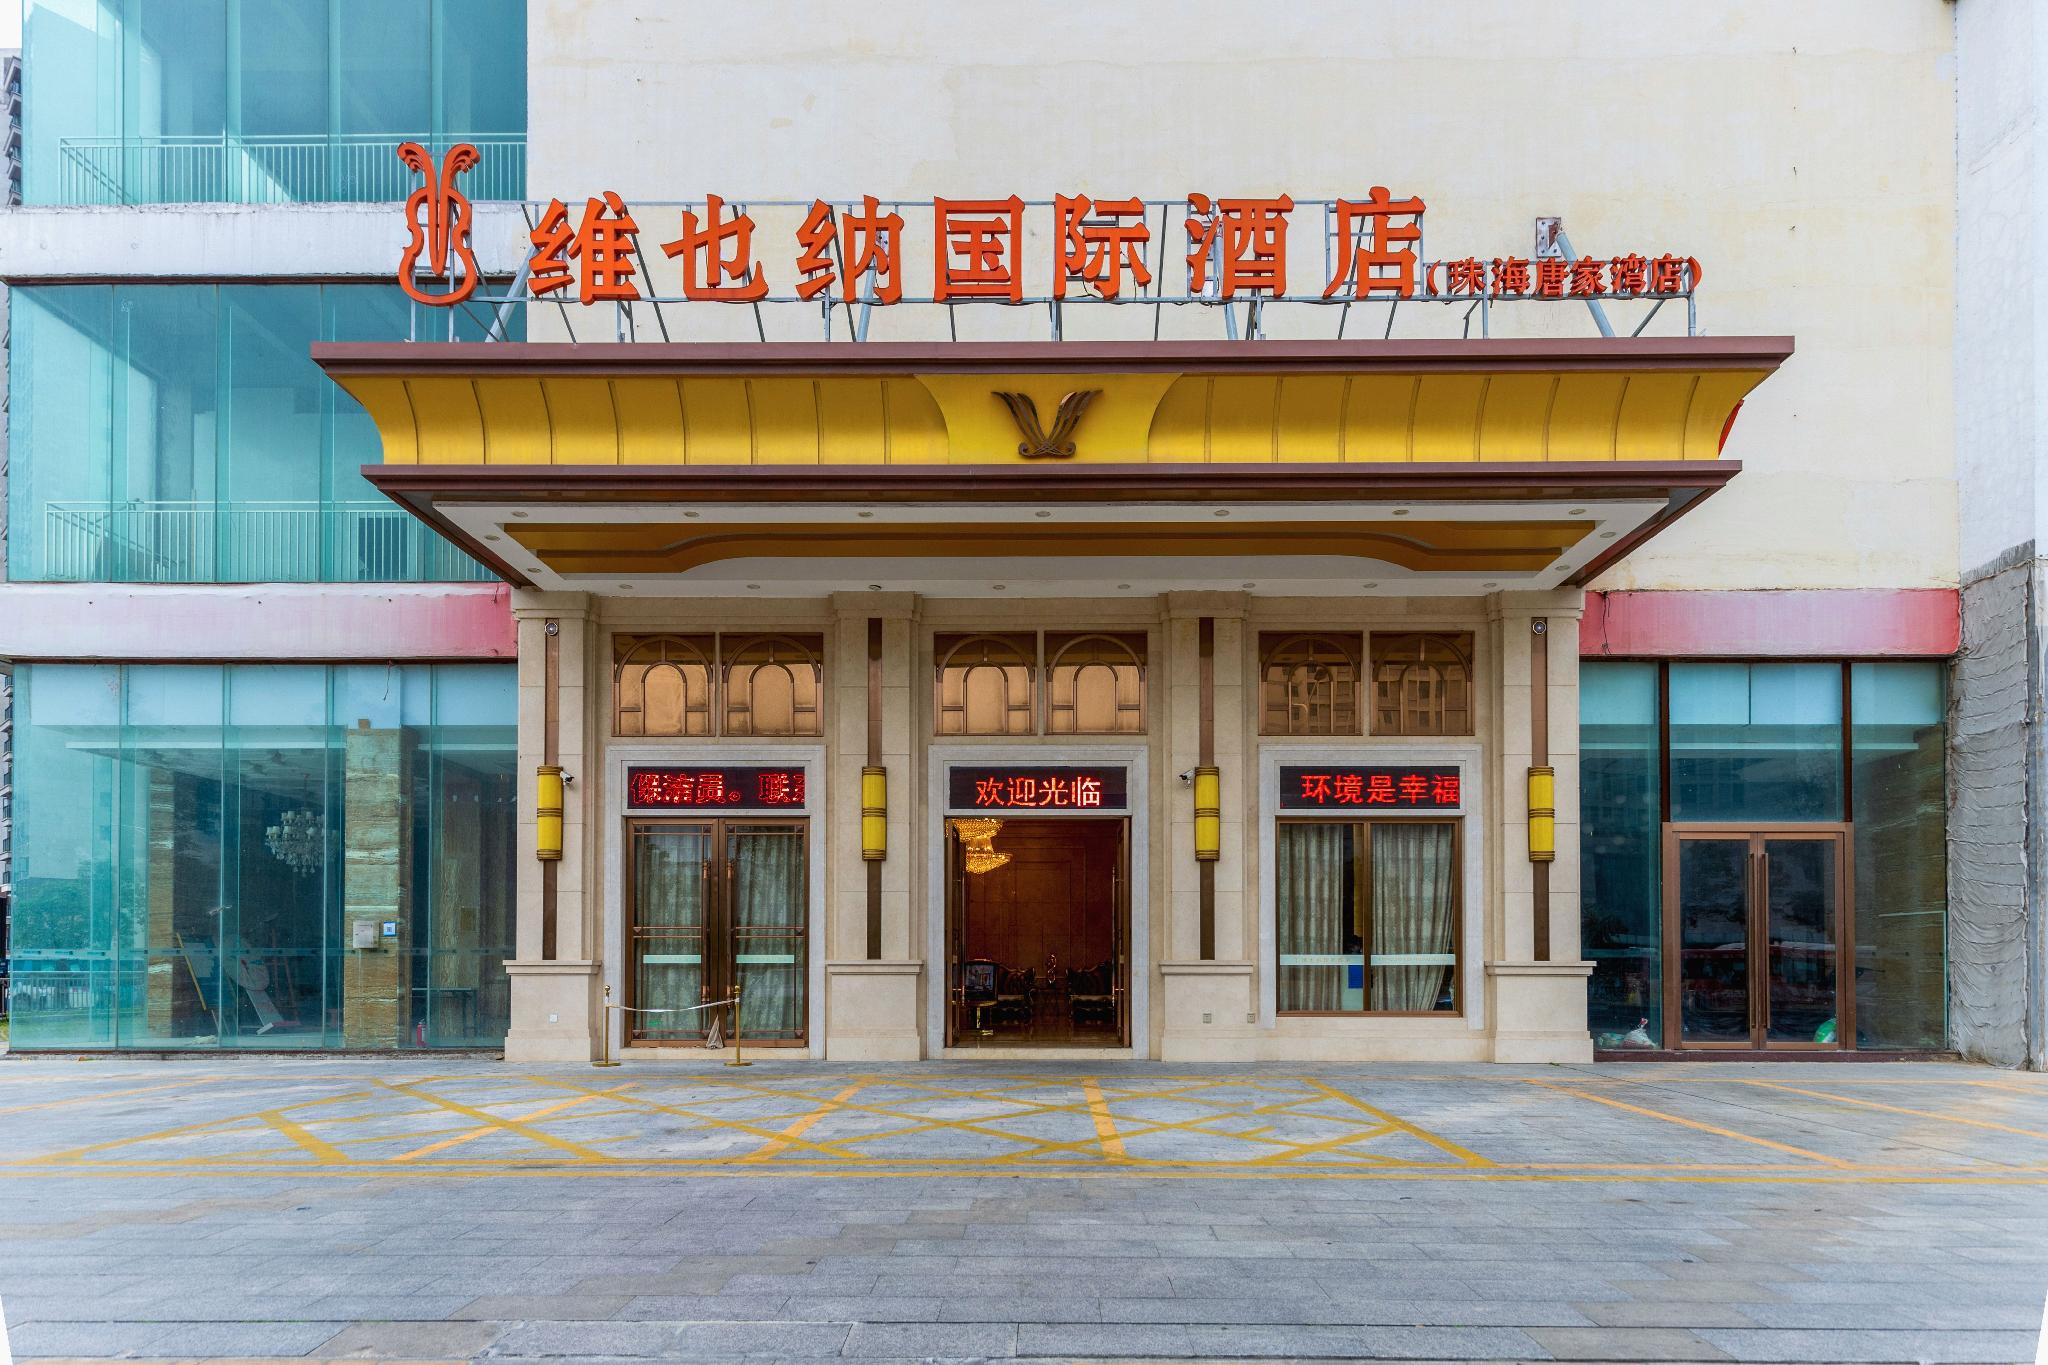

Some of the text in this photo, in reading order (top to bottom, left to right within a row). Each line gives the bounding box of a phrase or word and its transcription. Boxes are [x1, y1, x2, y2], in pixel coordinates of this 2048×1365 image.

[528, 186, 1426, 306] 维也纳国际酒店
[975, 776, 1102, 807] 欢迎光临
[1300, 774, 1460, 805] 环境是幸福
